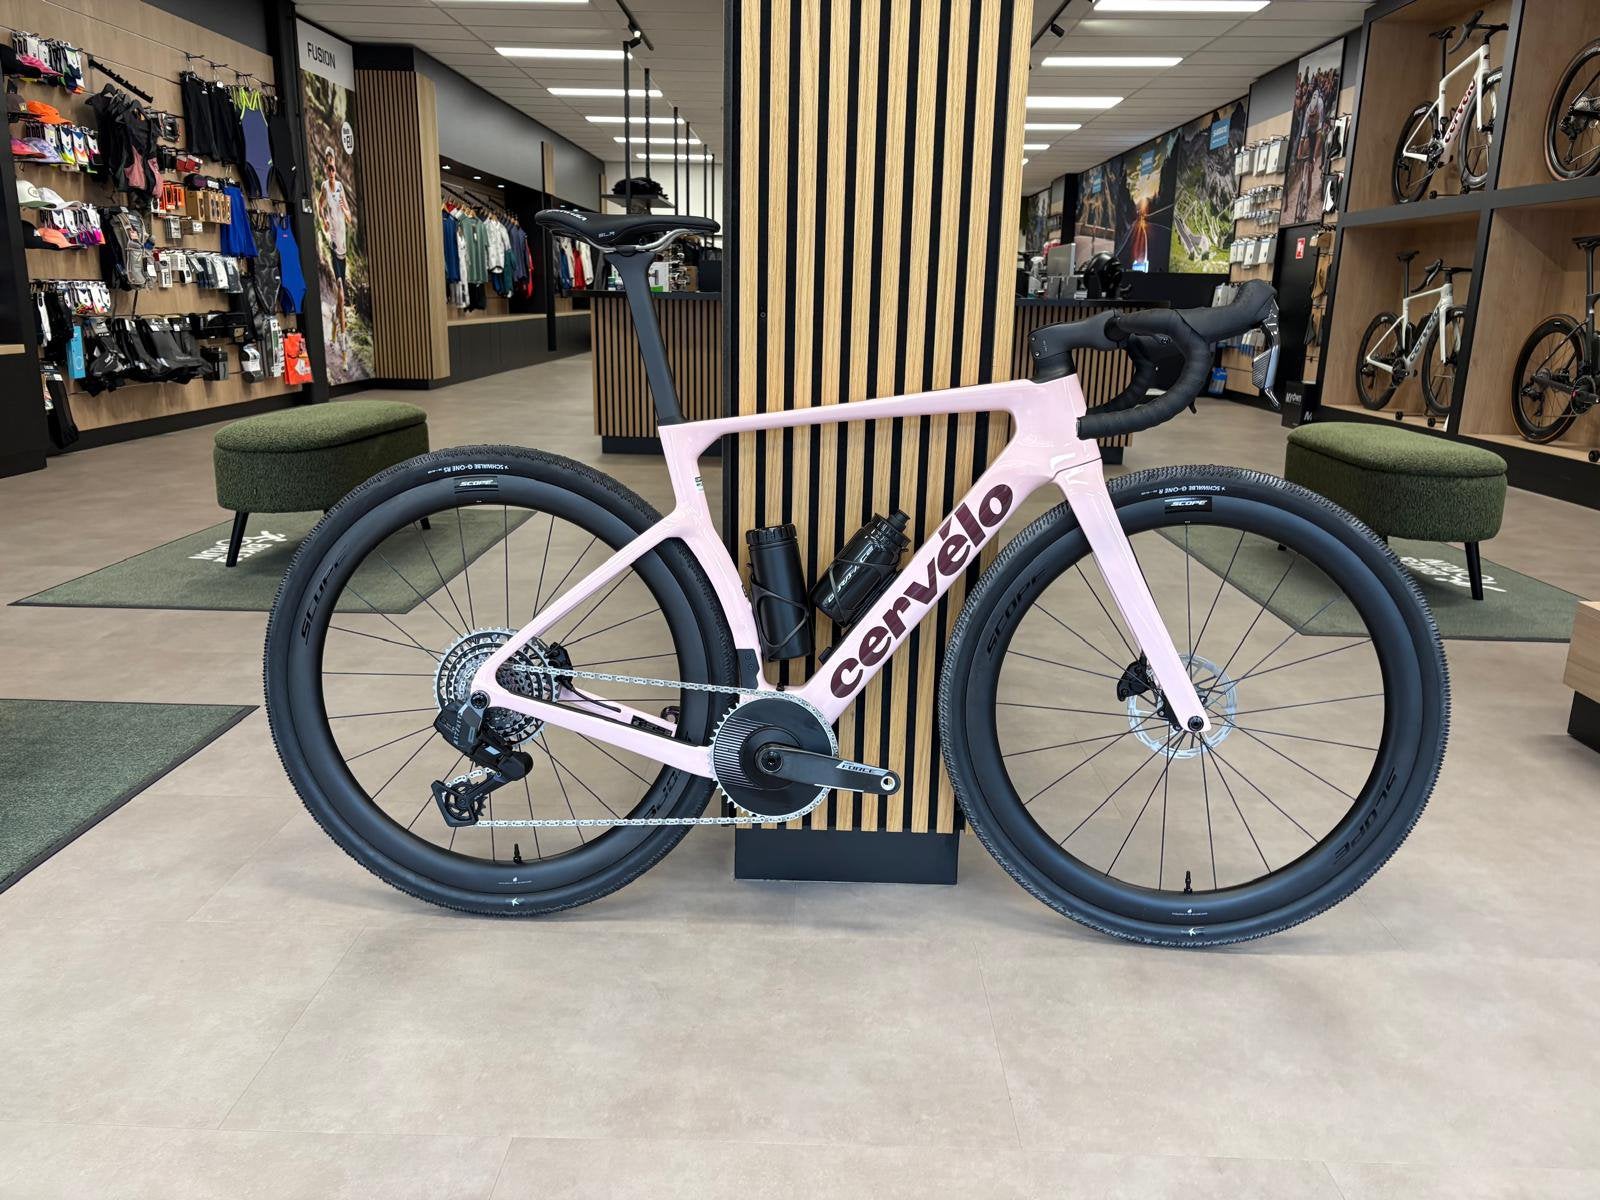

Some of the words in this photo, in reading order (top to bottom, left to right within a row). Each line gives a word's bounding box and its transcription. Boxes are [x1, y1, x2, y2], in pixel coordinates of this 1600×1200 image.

[307, 42, 336, 69] FUSION
[459, 479, 494, 487] SCOPE
[830, 483, 1014, 699] cervélo
